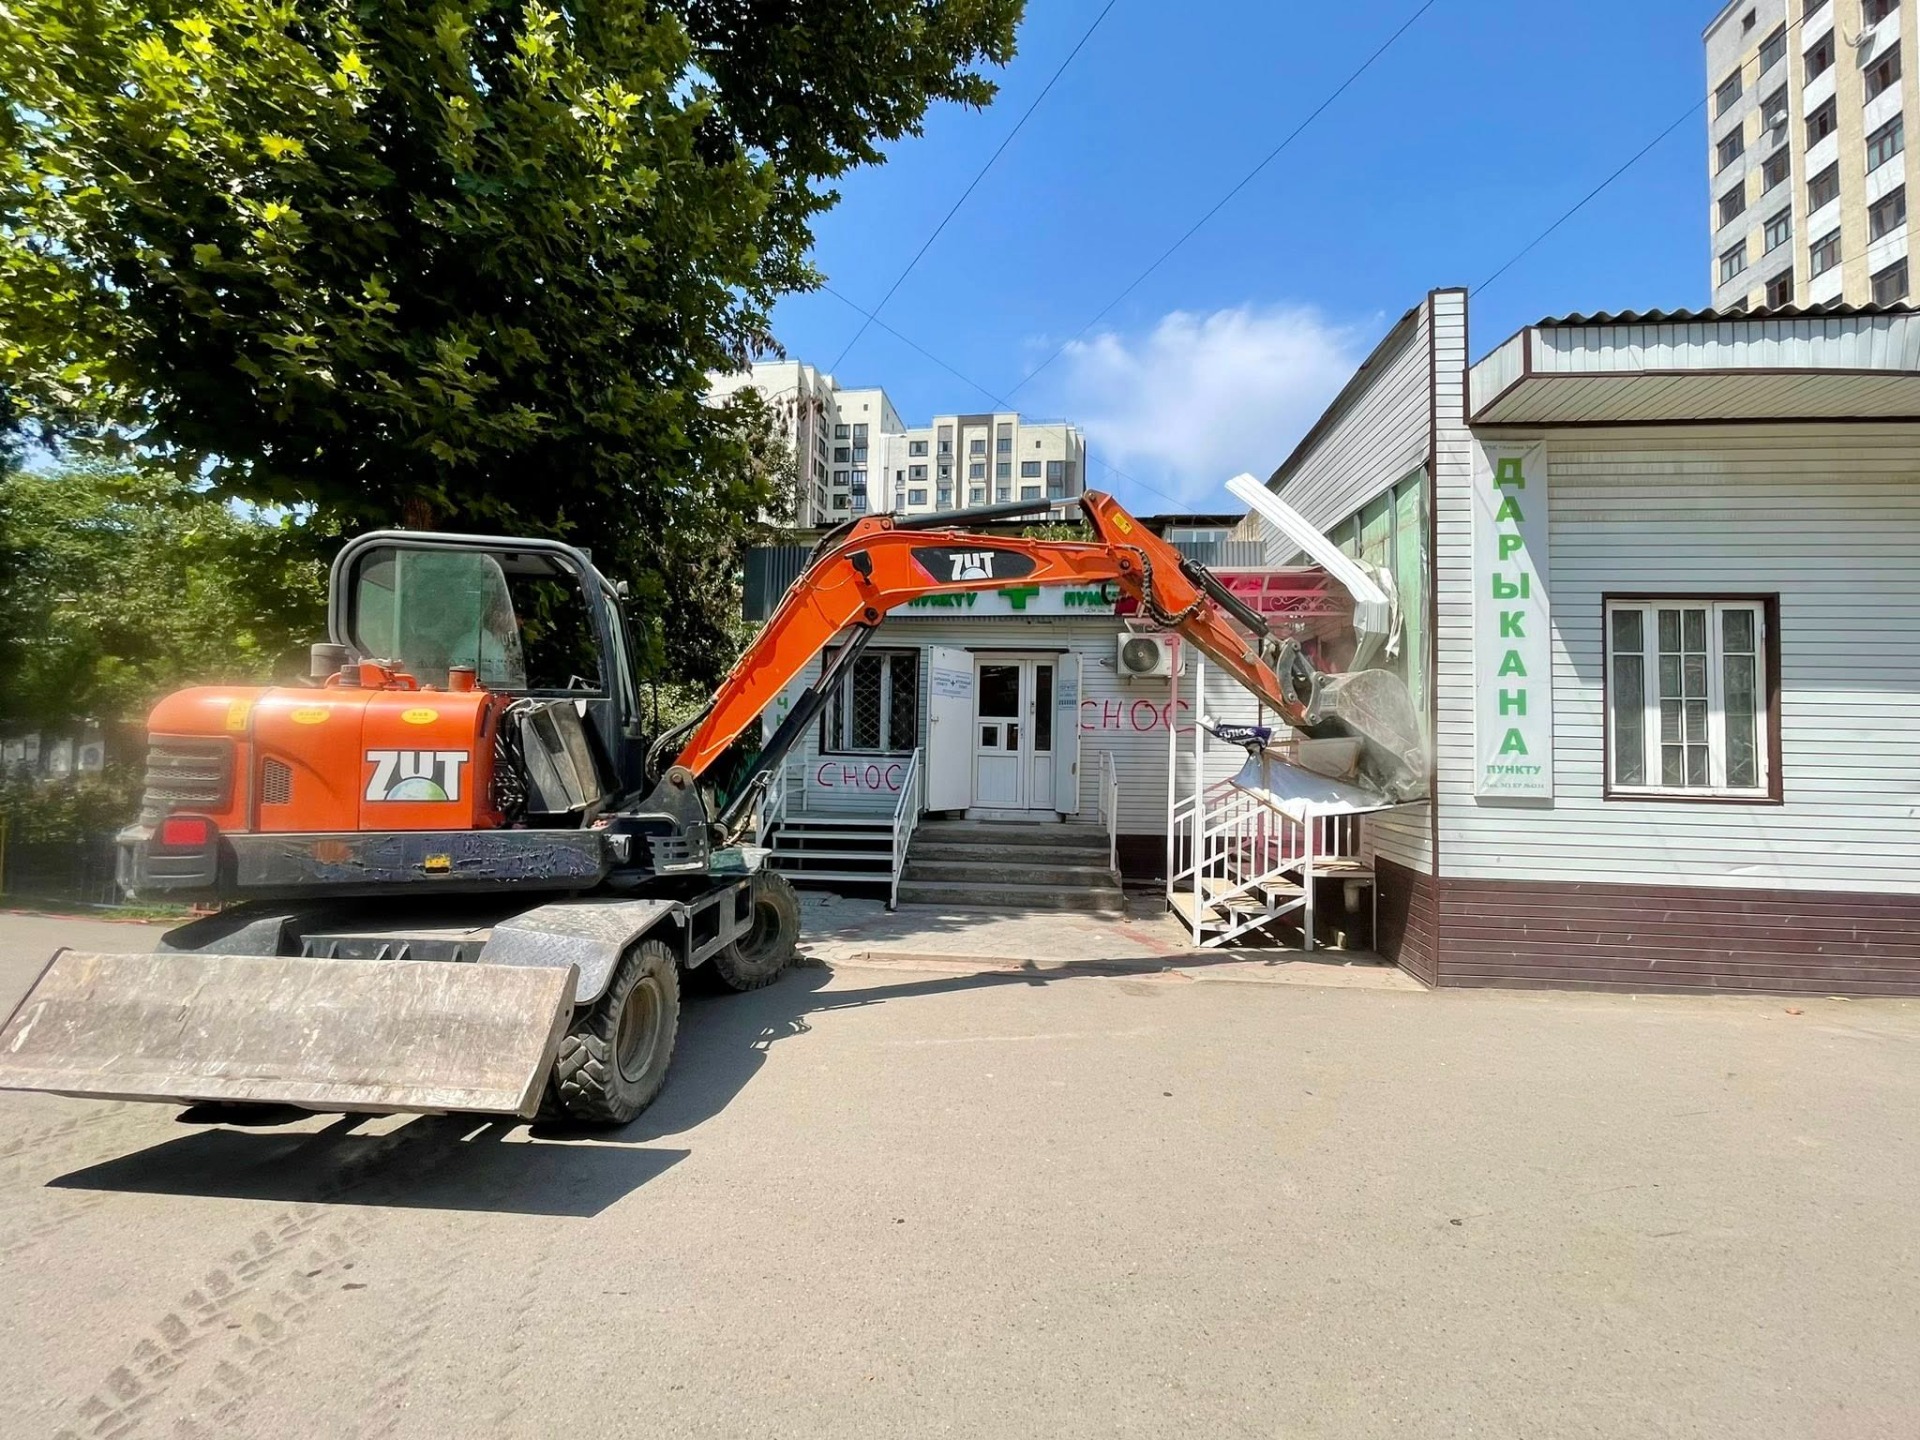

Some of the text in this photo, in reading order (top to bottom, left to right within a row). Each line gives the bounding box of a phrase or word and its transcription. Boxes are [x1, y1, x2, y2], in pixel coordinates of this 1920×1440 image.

[949, 551, 995, 581] ZUT
[1492, 457, 1531, 756] ДАРЫКАНА
[1080, 699, 1197, 734] СНОС
[365, 750, 470, 802] ZUT
[817, 761, 903, 792] СНОС
[1486, 765, 1542, 775] ПУНКТУ
